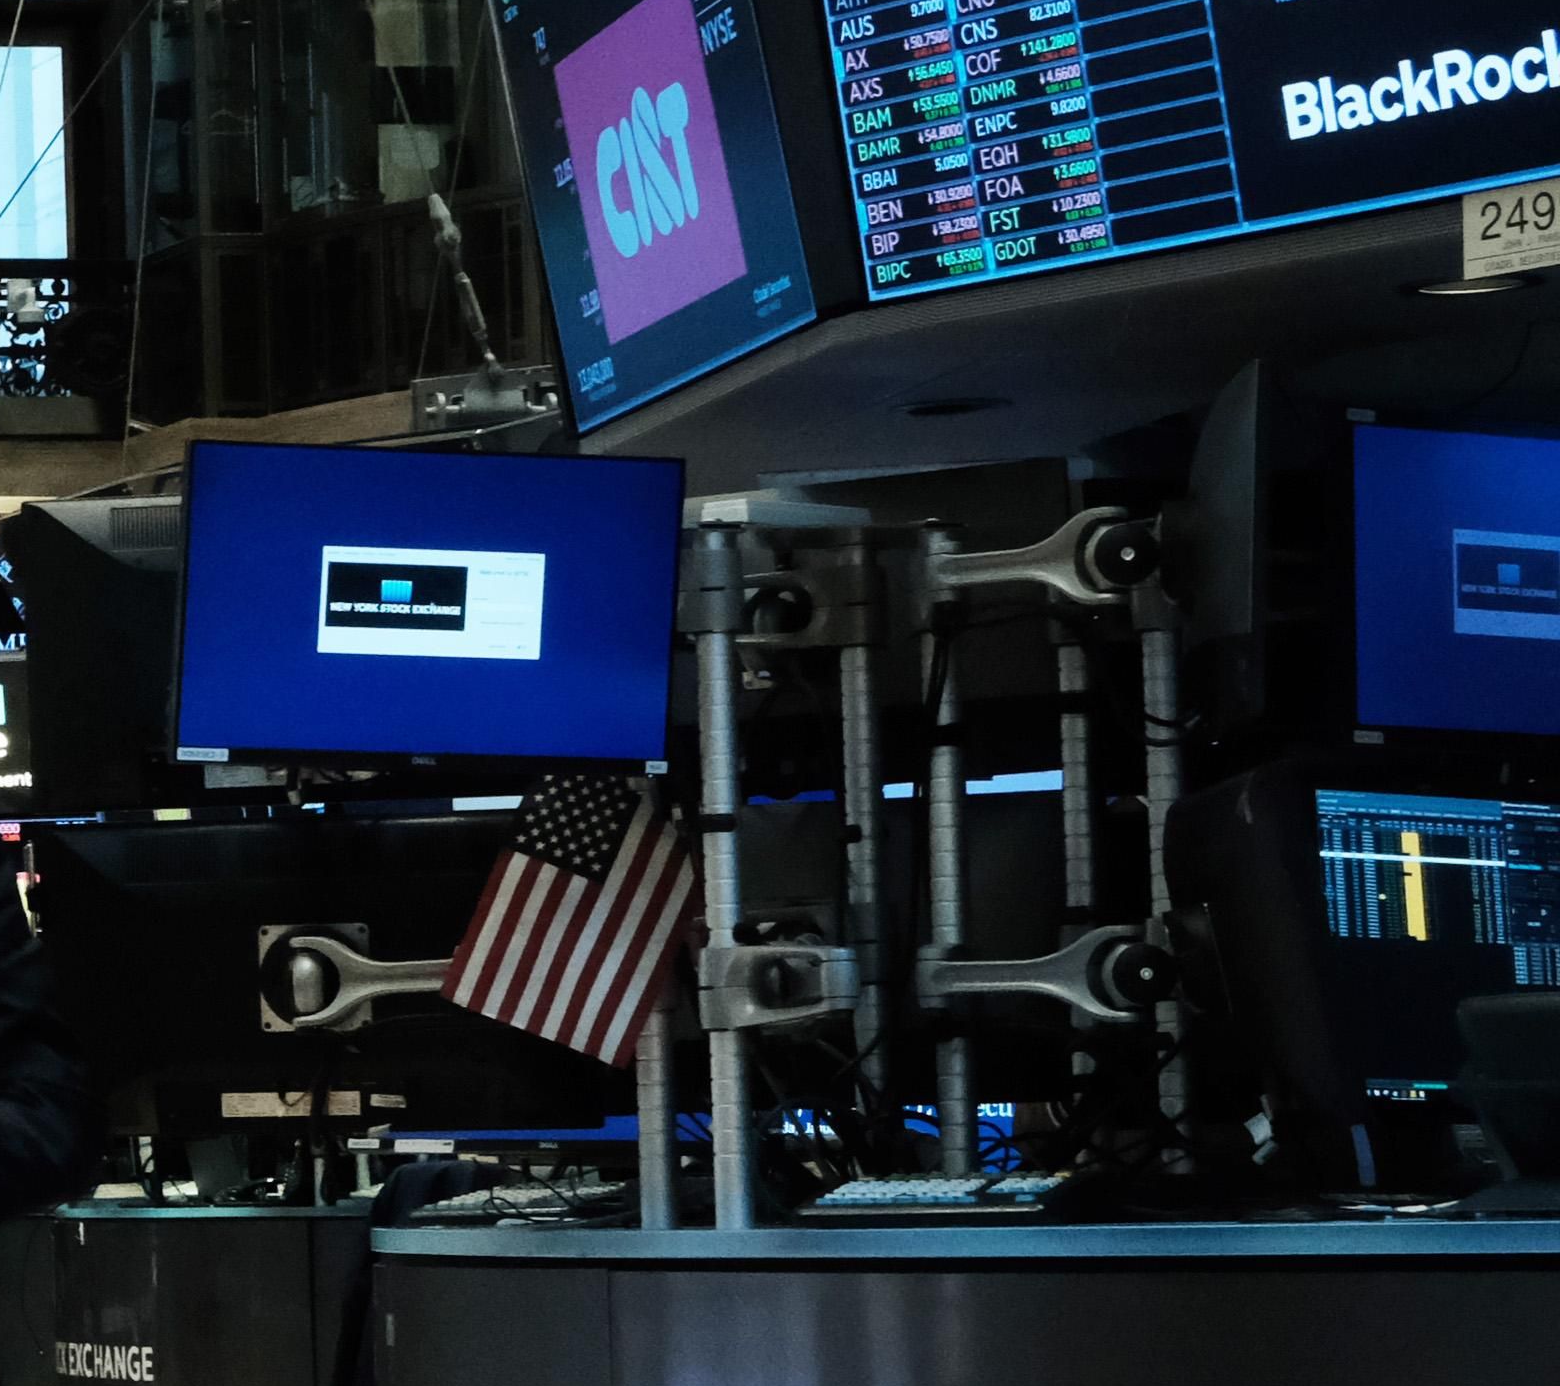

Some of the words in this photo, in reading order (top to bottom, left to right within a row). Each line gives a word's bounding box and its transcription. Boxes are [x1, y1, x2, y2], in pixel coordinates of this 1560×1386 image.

[699, 5, 738, 57] NYSE
[960, 17, 999, 45] CNS
[970, 78, 1018, 106] DNMR
[857, 137, 902, 162] BAMR
[68, 1341, 155, 1383] EXCHANGE
